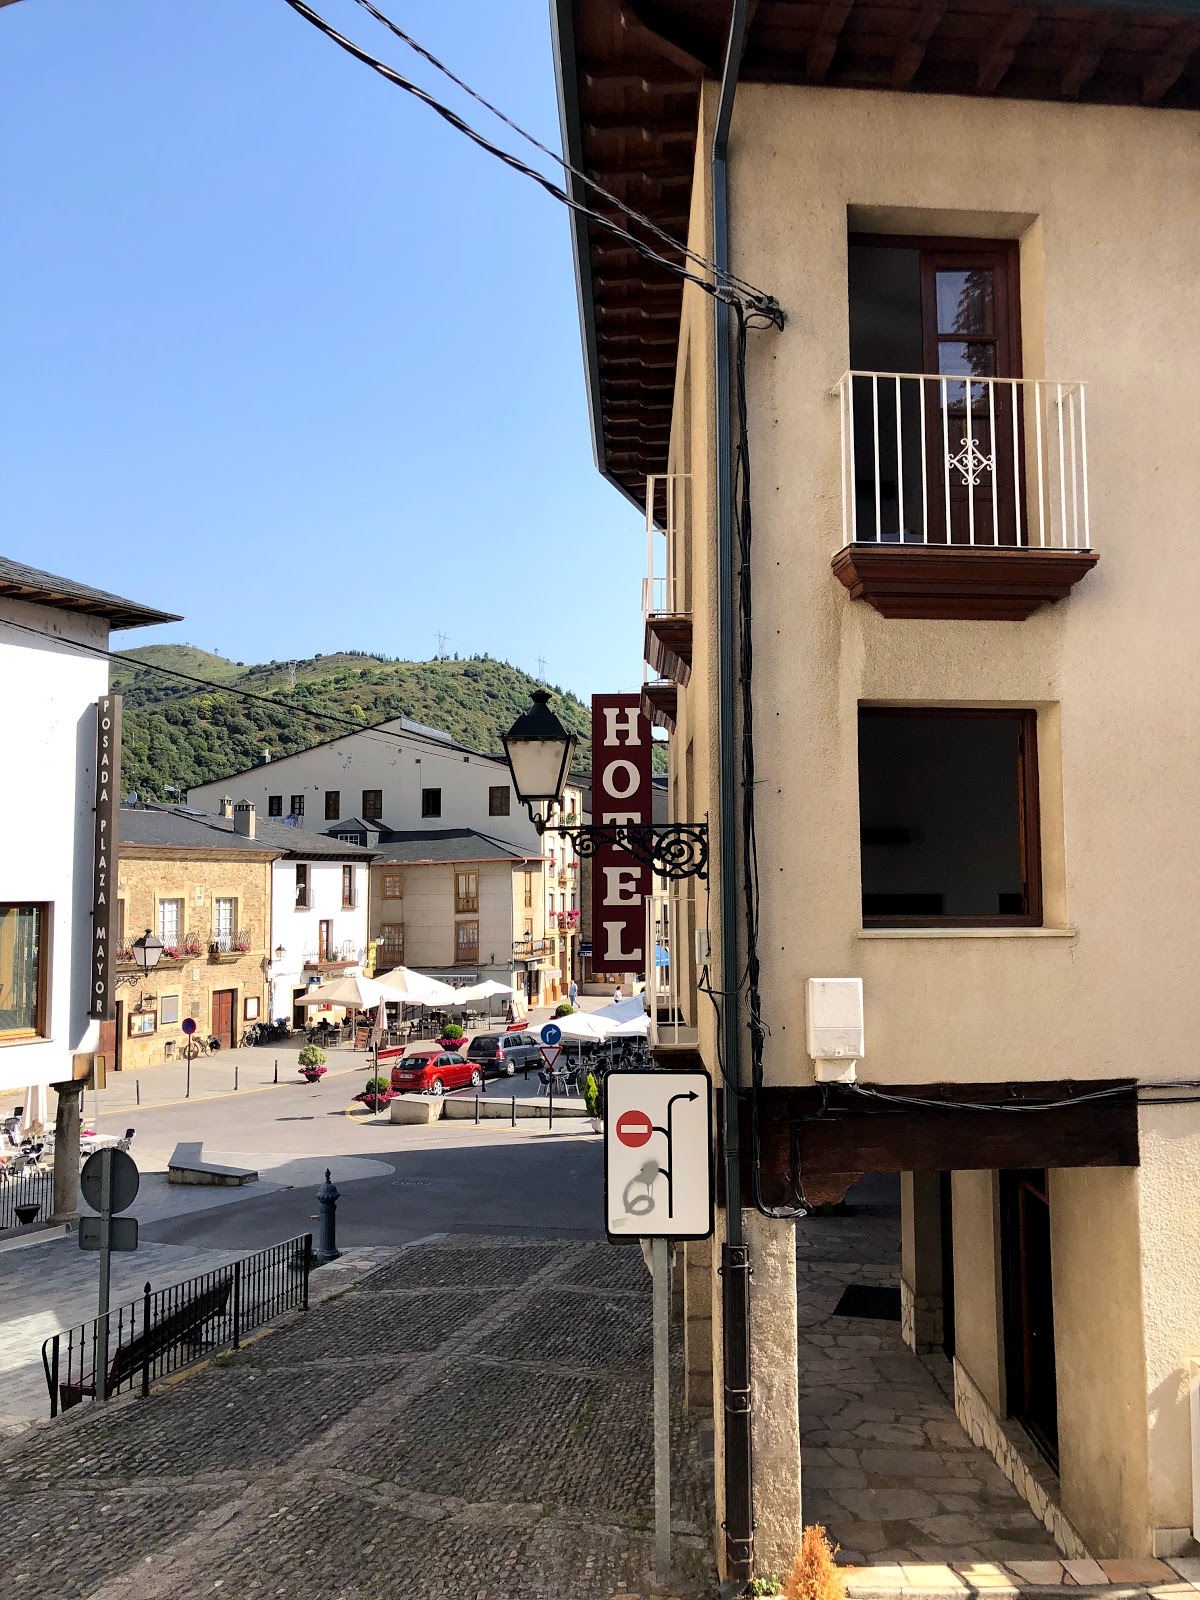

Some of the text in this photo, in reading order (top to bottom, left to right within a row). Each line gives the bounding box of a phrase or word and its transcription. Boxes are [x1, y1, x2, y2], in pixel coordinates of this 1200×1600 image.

[95, 700, 111, 1013] POSADA PLAZA MAYOR
[602, 707, 642, 961] HOTEL
